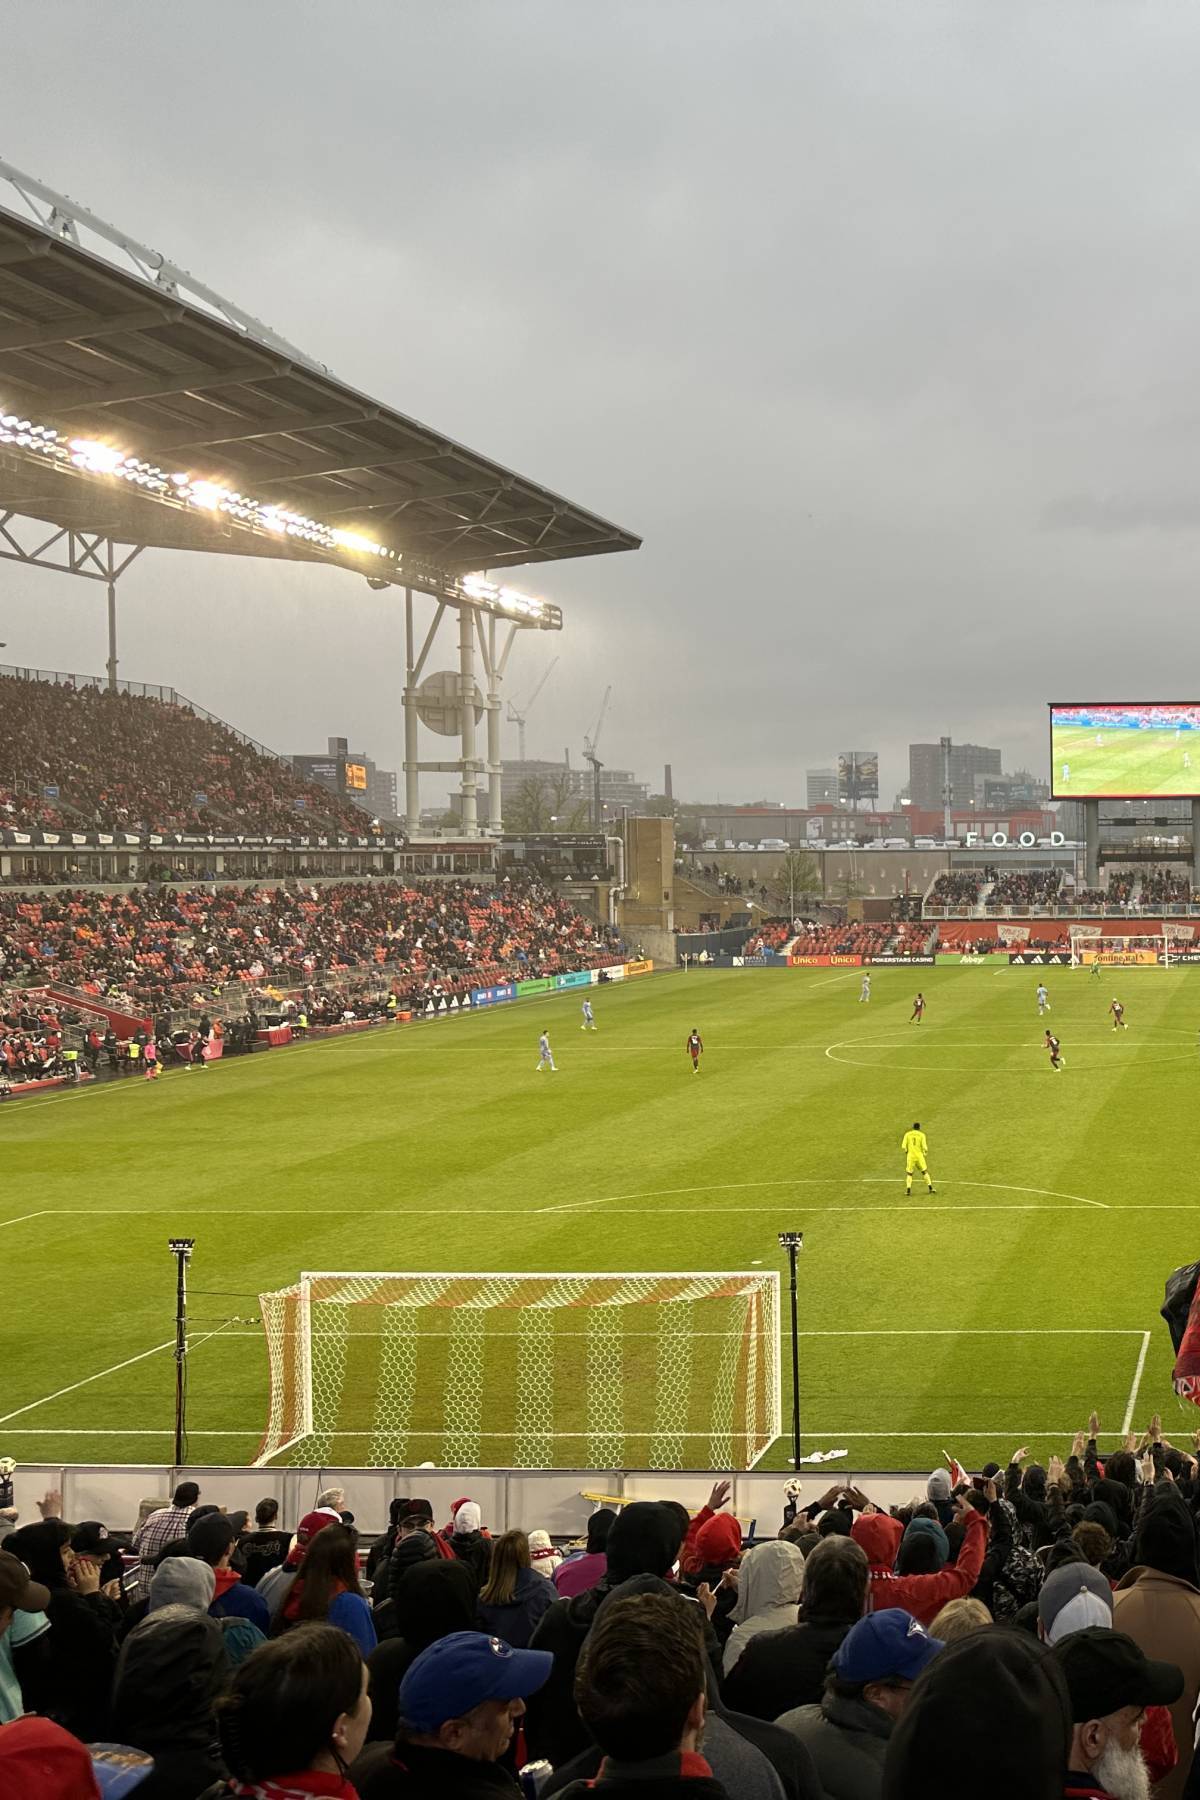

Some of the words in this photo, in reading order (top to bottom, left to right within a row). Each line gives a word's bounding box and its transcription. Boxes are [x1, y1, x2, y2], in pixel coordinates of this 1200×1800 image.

[966, 831, 1065, 847] FOOD
[793, 956, 818, 964] Unico
[830, 955, 856, 964] Unico
